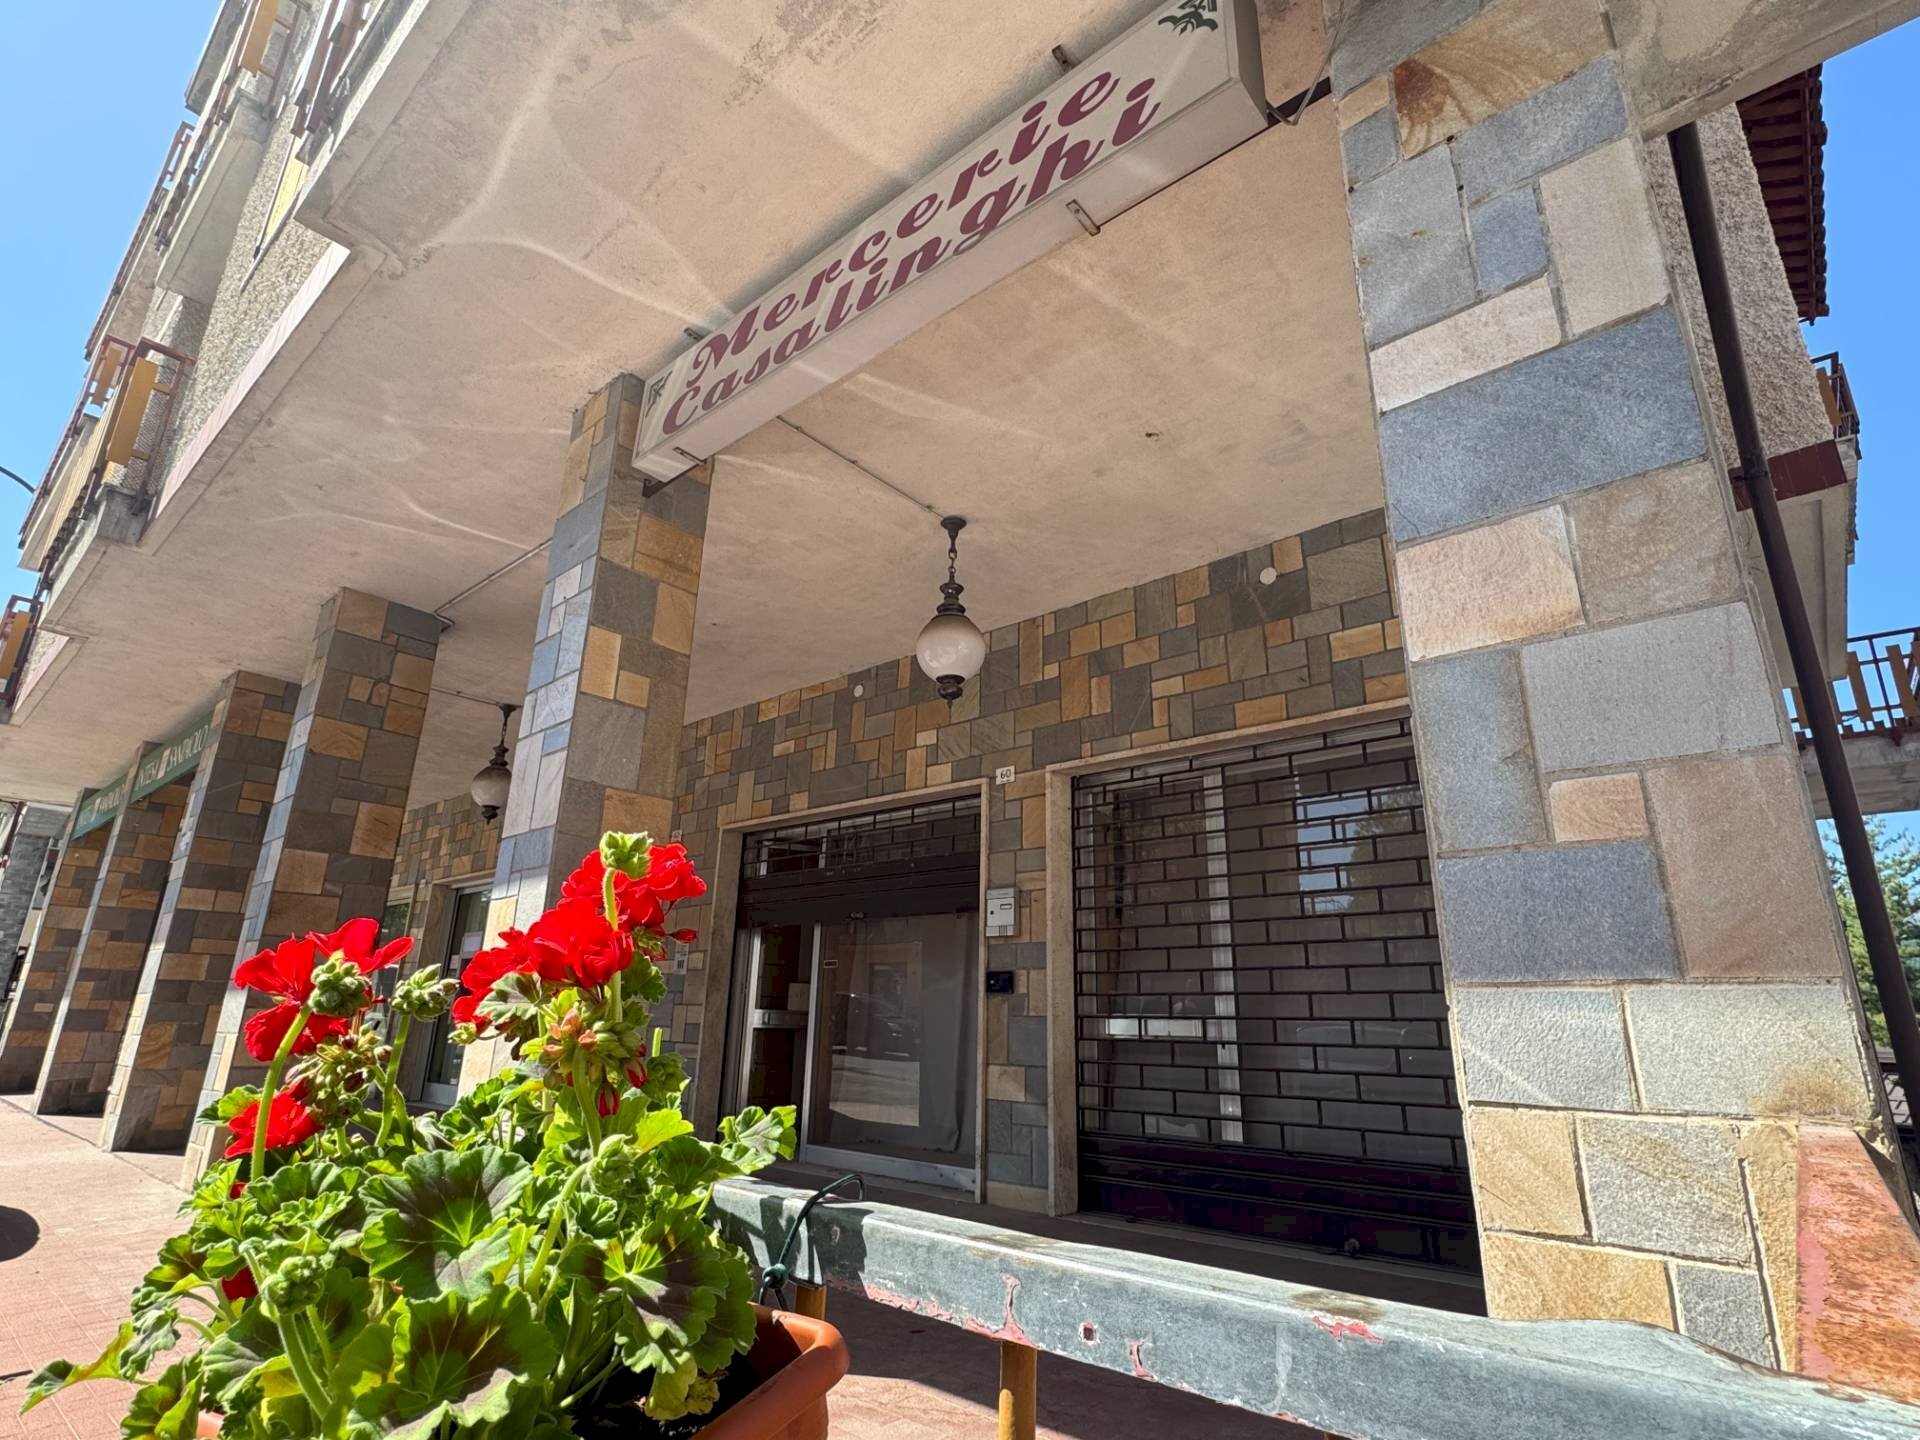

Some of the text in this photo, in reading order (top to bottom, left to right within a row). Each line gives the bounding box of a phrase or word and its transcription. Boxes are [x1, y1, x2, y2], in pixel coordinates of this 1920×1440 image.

[662, 78, 1161, 435] Casalinghi
[686, 71, 1120, 388] Mercerie
[1000, 769, 1011, 779] 60
